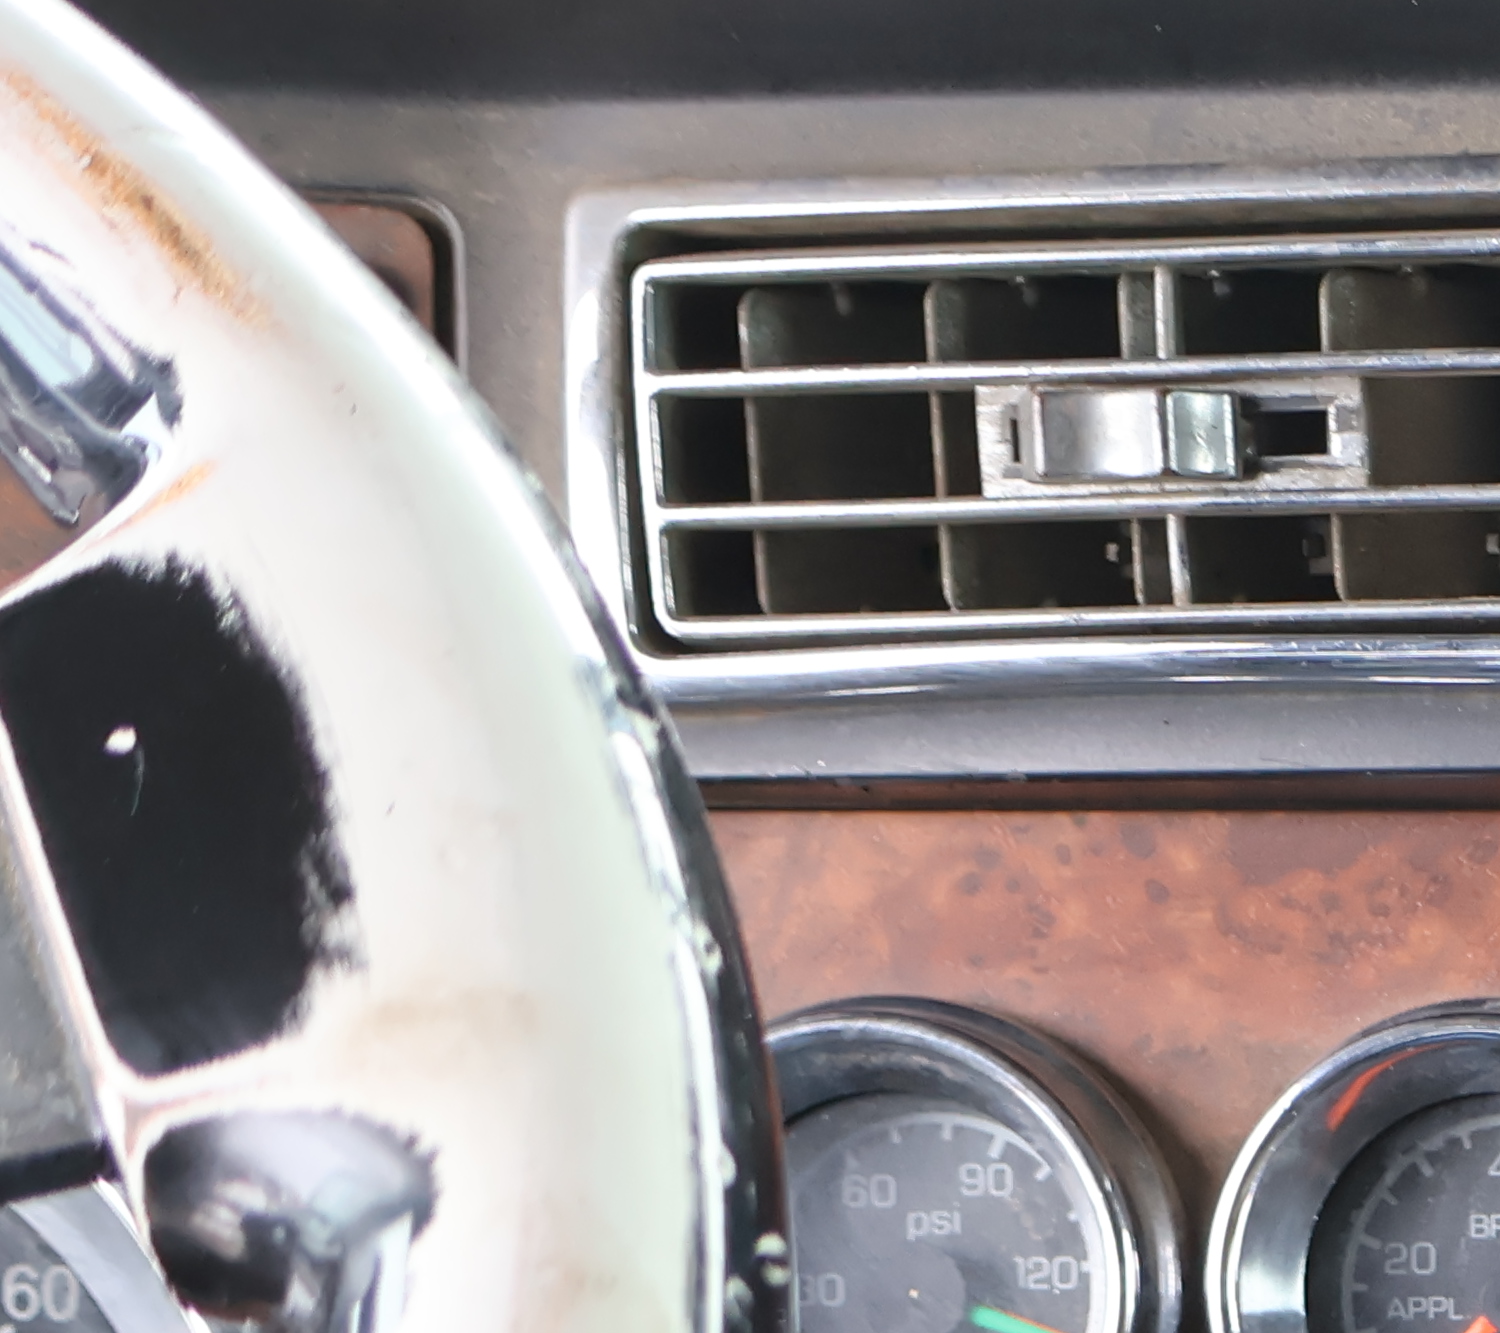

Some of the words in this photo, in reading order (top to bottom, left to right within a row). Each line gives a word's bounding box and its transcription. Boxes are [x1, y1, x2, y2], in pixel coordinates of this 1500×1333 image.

[843, 1173, 897, 1209] 60
[959, 1162, 1013, 1197] 90
[906, 1201, 962, 1240] psi
[1014, 1256, 1079, 1291] 120
[1383, 1242, 1437, 1275] 20
[2, 1264, 80, 1321] 60
